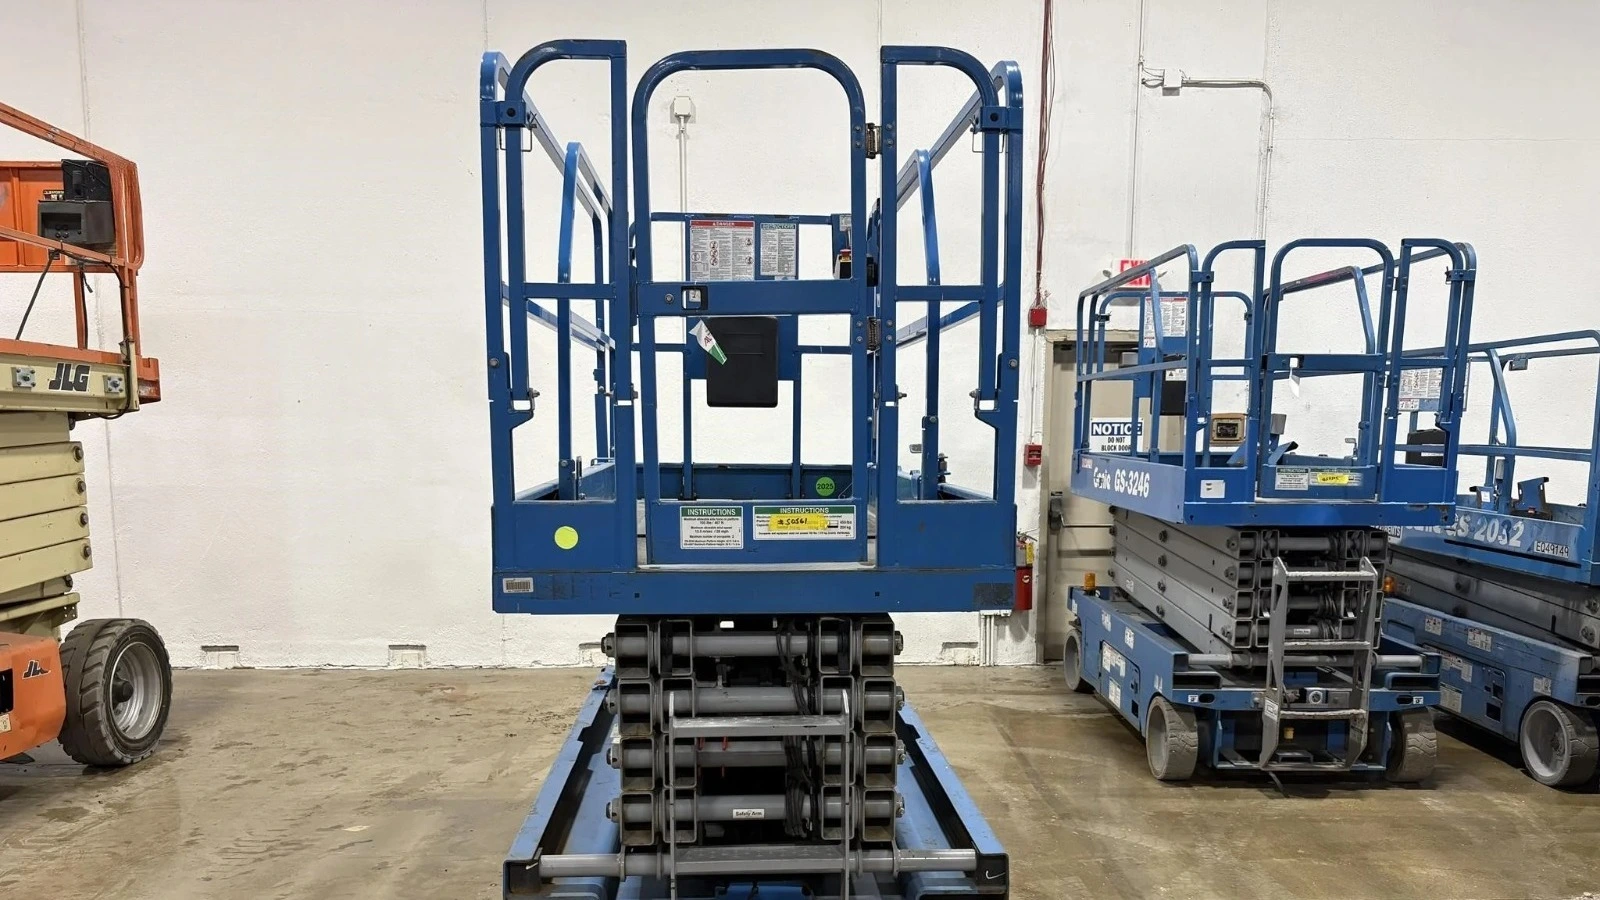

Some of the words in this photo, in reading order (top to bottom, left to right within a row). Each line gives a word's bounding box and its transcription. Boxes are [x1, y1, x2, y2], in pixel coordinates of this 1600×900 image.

[48, 362, 91, 392] JLG
[1101, 444, 1117, 452] BLOCK
[687, 508, 736, 516] INSTRUCTIONS
